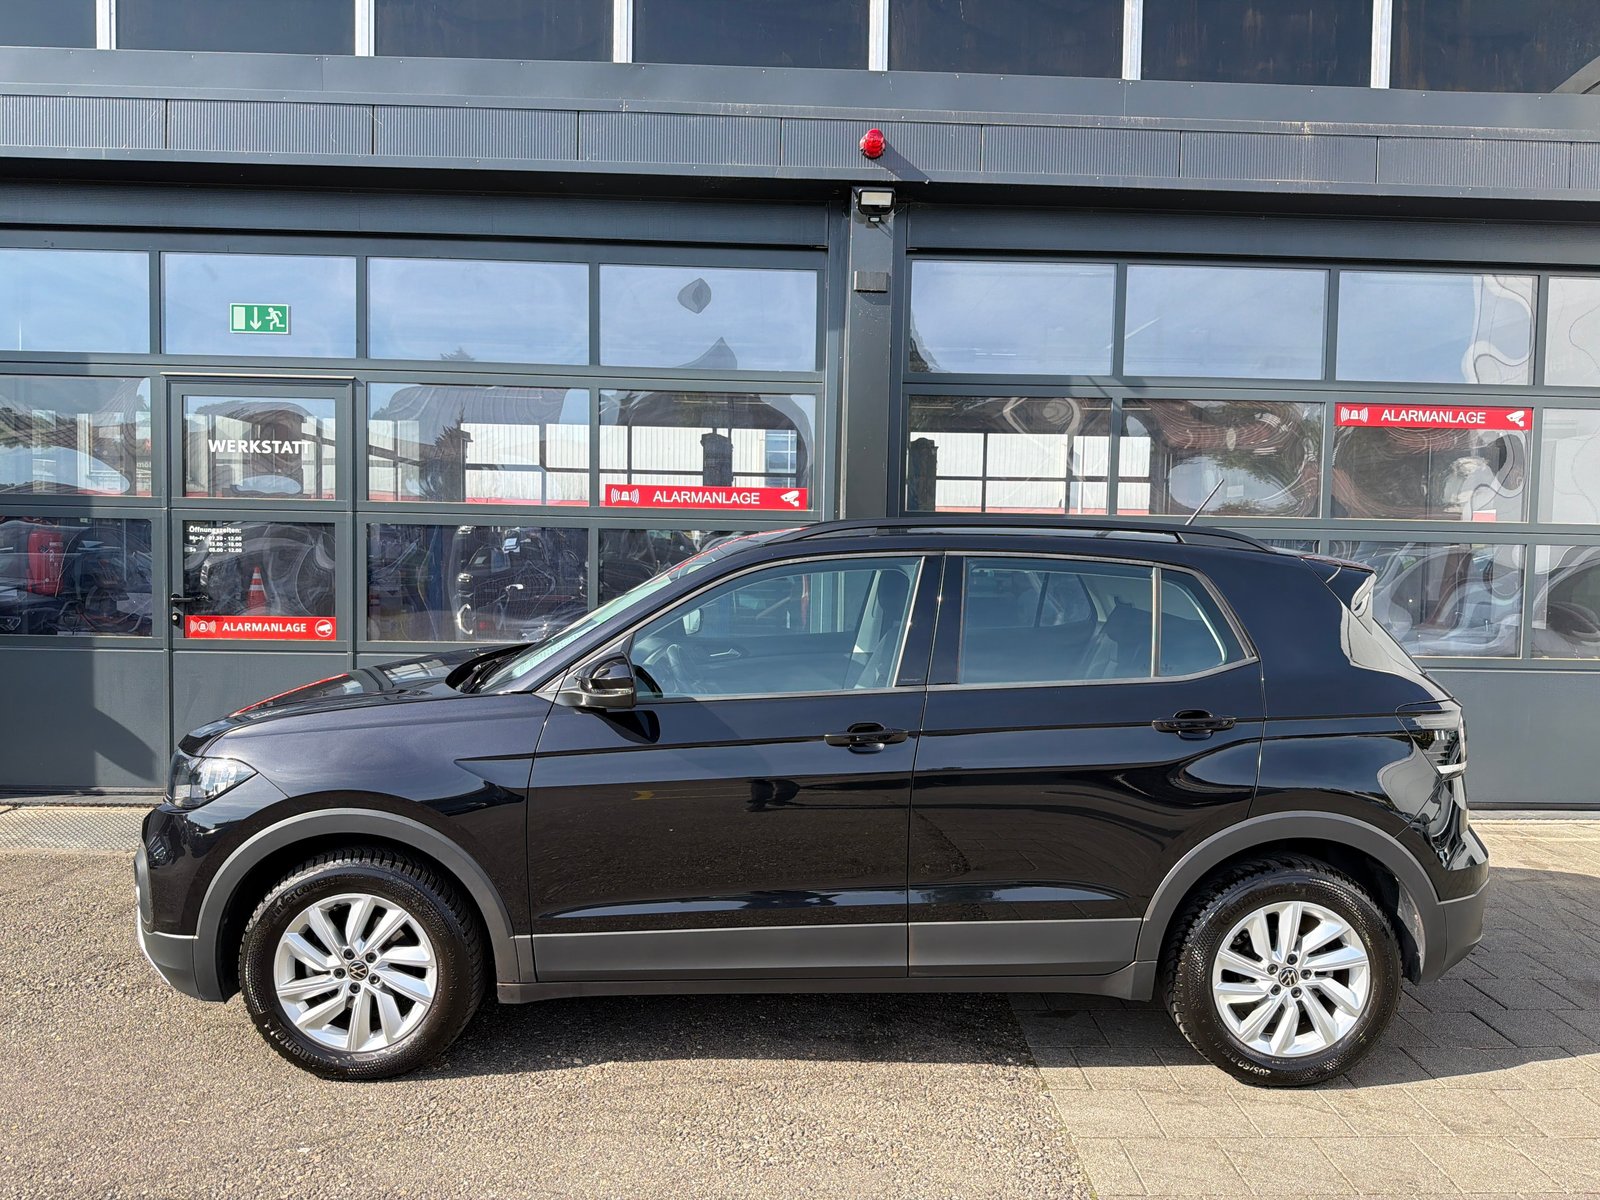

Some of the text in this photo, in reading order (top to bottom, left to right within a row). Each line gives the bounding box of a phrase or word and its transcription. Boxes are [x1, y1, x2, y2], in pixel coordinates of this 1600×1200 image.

[1381, 409, 1486, 424] ALARMANLAGE
[208, 439, 312, 454] WERKSTATT
[653, 490, 760, 504] ALARMANLAGE
[189, 525, 242, 535] Öffnungszeiten:
[222, 622, 307, 632] ALARMANLAGE
